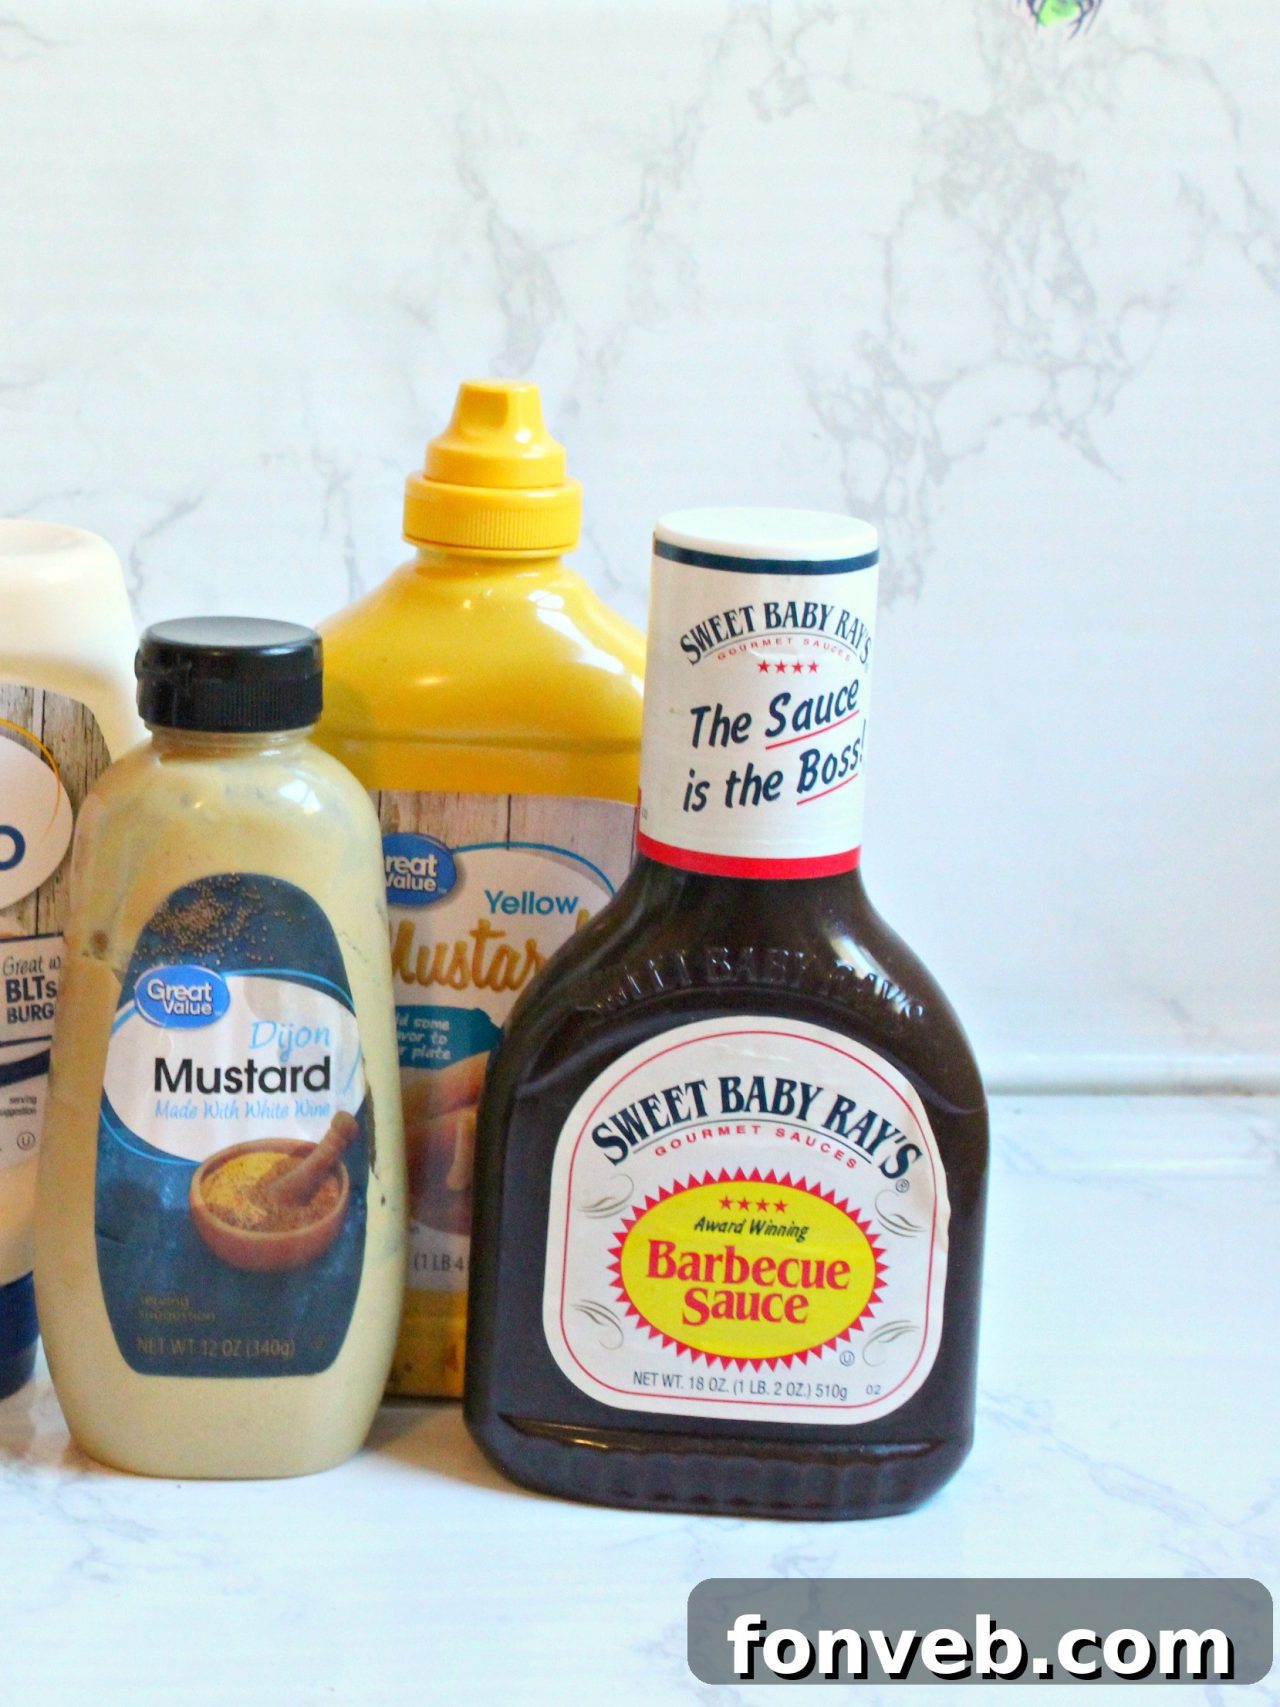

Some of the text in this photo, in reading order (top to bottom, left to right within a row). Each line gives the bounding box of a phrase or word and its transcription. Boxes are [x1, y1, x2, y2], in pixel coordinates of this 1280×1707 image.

[680, 601, 871, 666] SWEET BABY RAY'S
[717, 637, 852, 662] GOURMET SAUCES
[691, 679, 859, 749] The Sauce
[683, 768, 710, 813] is
[725, 763, 784, 810] the
[384, 854, 437, 877] reat
[484, 890, 579, 915] Yellow
[6, 975, 57, 1003] BLTs
[147, 978, 213, 1003] Great
[163, 1000, 213, 1016] Value
[249, 1020, 330, 1063] Dijon
[154, 1055, 331, 1095] Mustard
[155, 1098, 331, 1120] Made With White Wine
[591, 1075, 923, 1180] SWEET BABY RAY'S
[654, 1124, 857, 1170] GOURMET SAUCES
[693, 1216, 810, 1243] Award Winning
[645, 1239, 851, 1291] Barbecue
[681, 1285, 809, 1327] Sauce
[633, 1371, 658, 1386] NET
[661, 1373, 684, 1390] WT.
[689, 1376, 704, 1391] 18
[708, 1377, 729, 1393] OZ.
[732, 1379, 744, 1395] (1
[749, 1381, 770, 1396] LB.
[774, 1382, 782, 1396] 2
[786, 1381, 812, 1398] OZ.)
[815, 1383, 848, 1401] 510g
